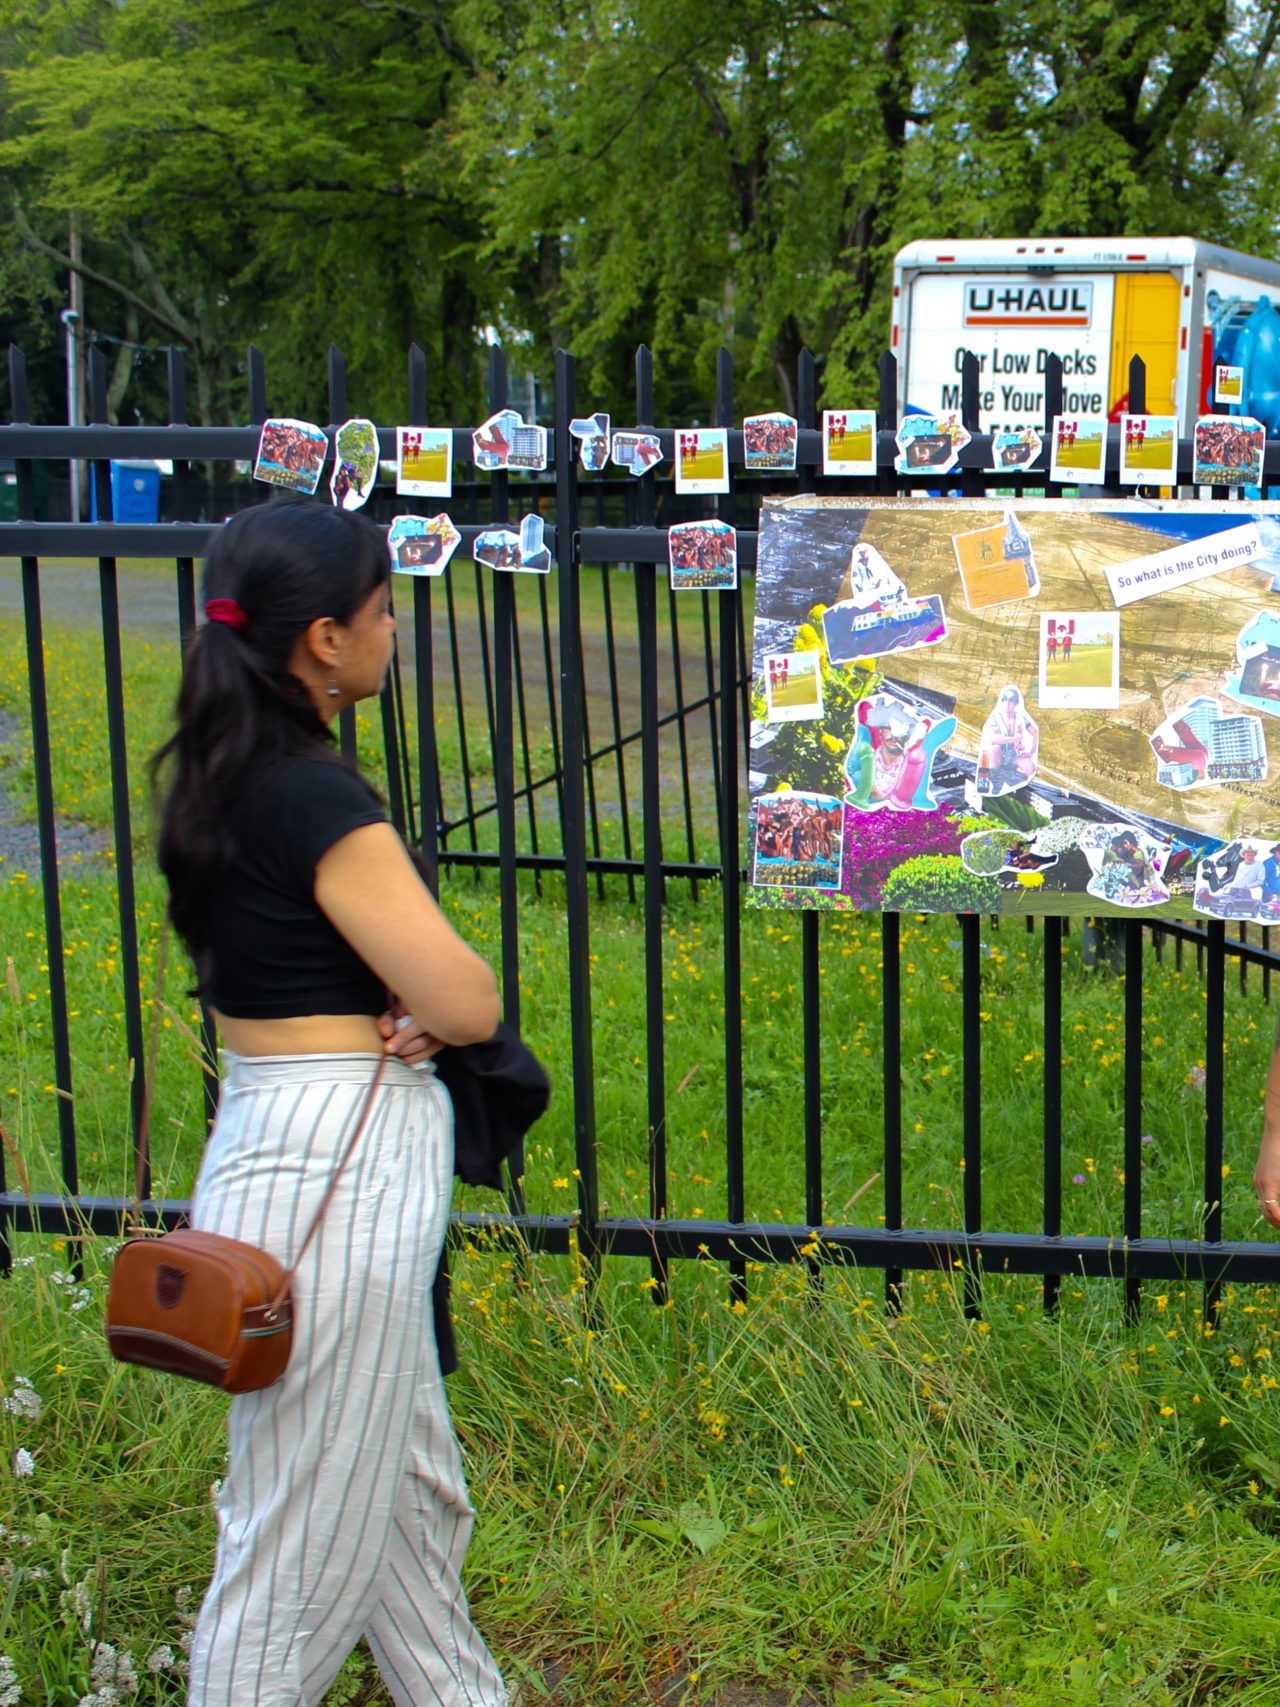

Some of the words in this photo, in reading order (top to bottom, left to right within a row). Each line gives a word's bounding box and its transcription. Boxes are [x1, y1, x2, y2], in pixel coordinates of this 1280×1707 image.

[970, 287, 1087, 313] U-HAUL
[955, 347, 988, 374] Or
[992, 348, 1031, 375] Low
[1035, 348, 1098, 376] Dcks
[1001, 385, 1044, 413] Your
[1117, 576, 1132, 588] So
[1134, 568, 1163, 584] what
[1164, 564, 1174, 576] is
[1175, 560, 1195, 573] the
[1196, 551, 1219, 567] City
[1221, 540, 1258, 561] doing?
